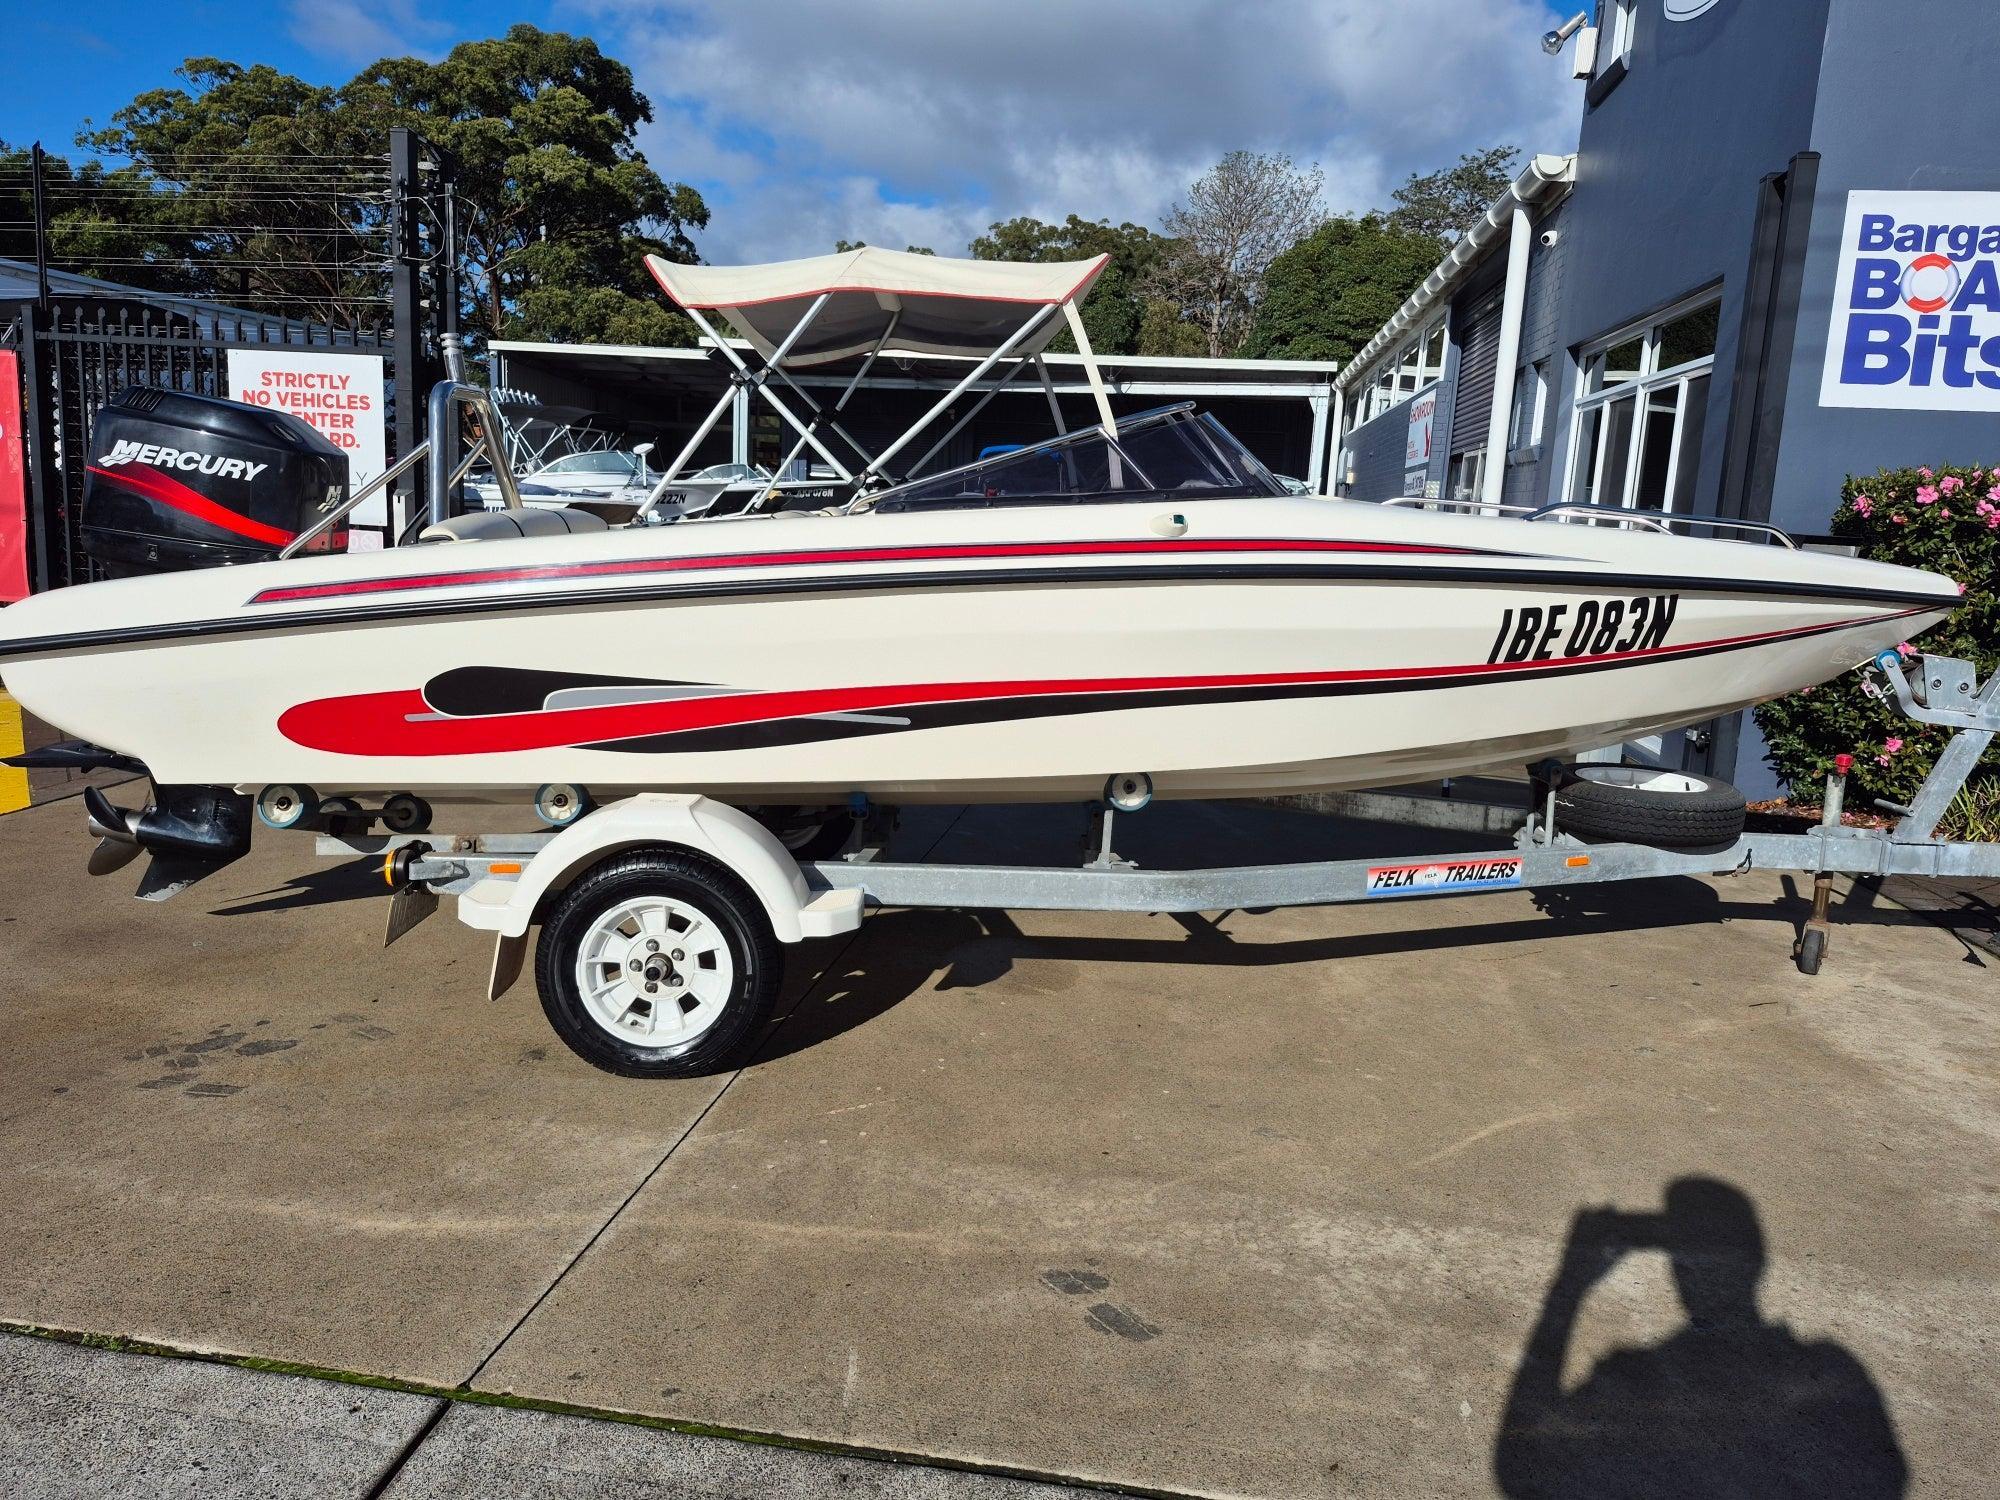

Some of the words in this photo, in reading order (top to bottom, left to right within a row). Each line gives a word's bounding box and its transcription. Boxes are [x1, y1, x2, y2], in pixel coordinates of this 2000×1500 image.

[261, 371, 350, 390] STRICTLY
[242, 389, 271, 406] NO
[276, 391, 371, 411] VEHICLES
[98, 439, 268, 482] MERCURY
[1487, 604, 1568, 664] IBE
[1563, 594, 1680, 658] 083N
[1373, 868, 1420, 889] FELK
[1445, 861, 1518, 883] TRAILERS
